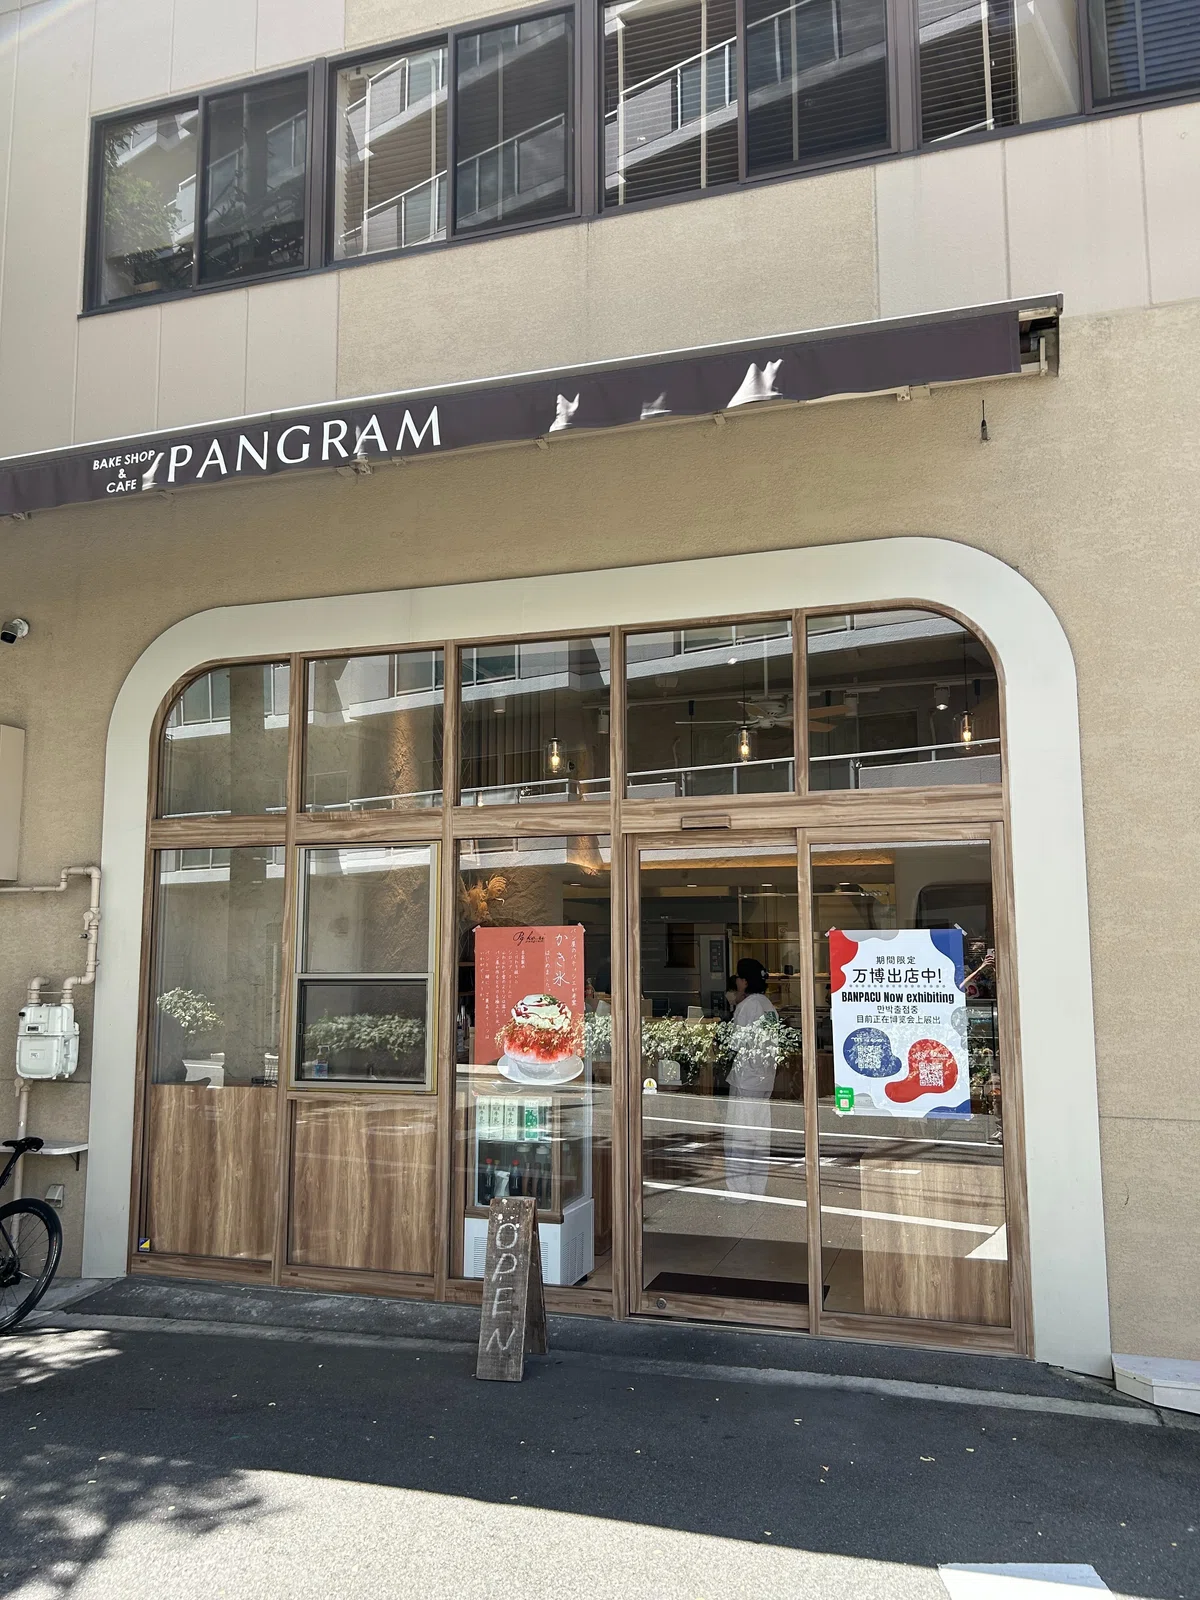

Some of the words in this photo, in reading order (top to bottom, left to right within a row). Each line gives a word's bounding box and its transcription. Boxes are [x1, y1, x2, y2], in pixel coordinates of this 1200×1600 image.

[168, 405, 441, 483] PANGRAM
[93, 456, 122, 470] BAKE
[124, 450, 155, 465] SHOP
[118, 468, 127, 479] &
[106, 479, 137, 493] CAFE
[553, 933, 570, 987] かき氷
[876, 955, 916, 965] 期間限定
[852, 967, 942, 984] 万博出店中!
[841, 991, 881, 1003] BANPACU
[883, 991, 904, 1003] Now
[906, 991, 955, 1004] exhibiting
[486, 1222, 518, 1352] OPEN
